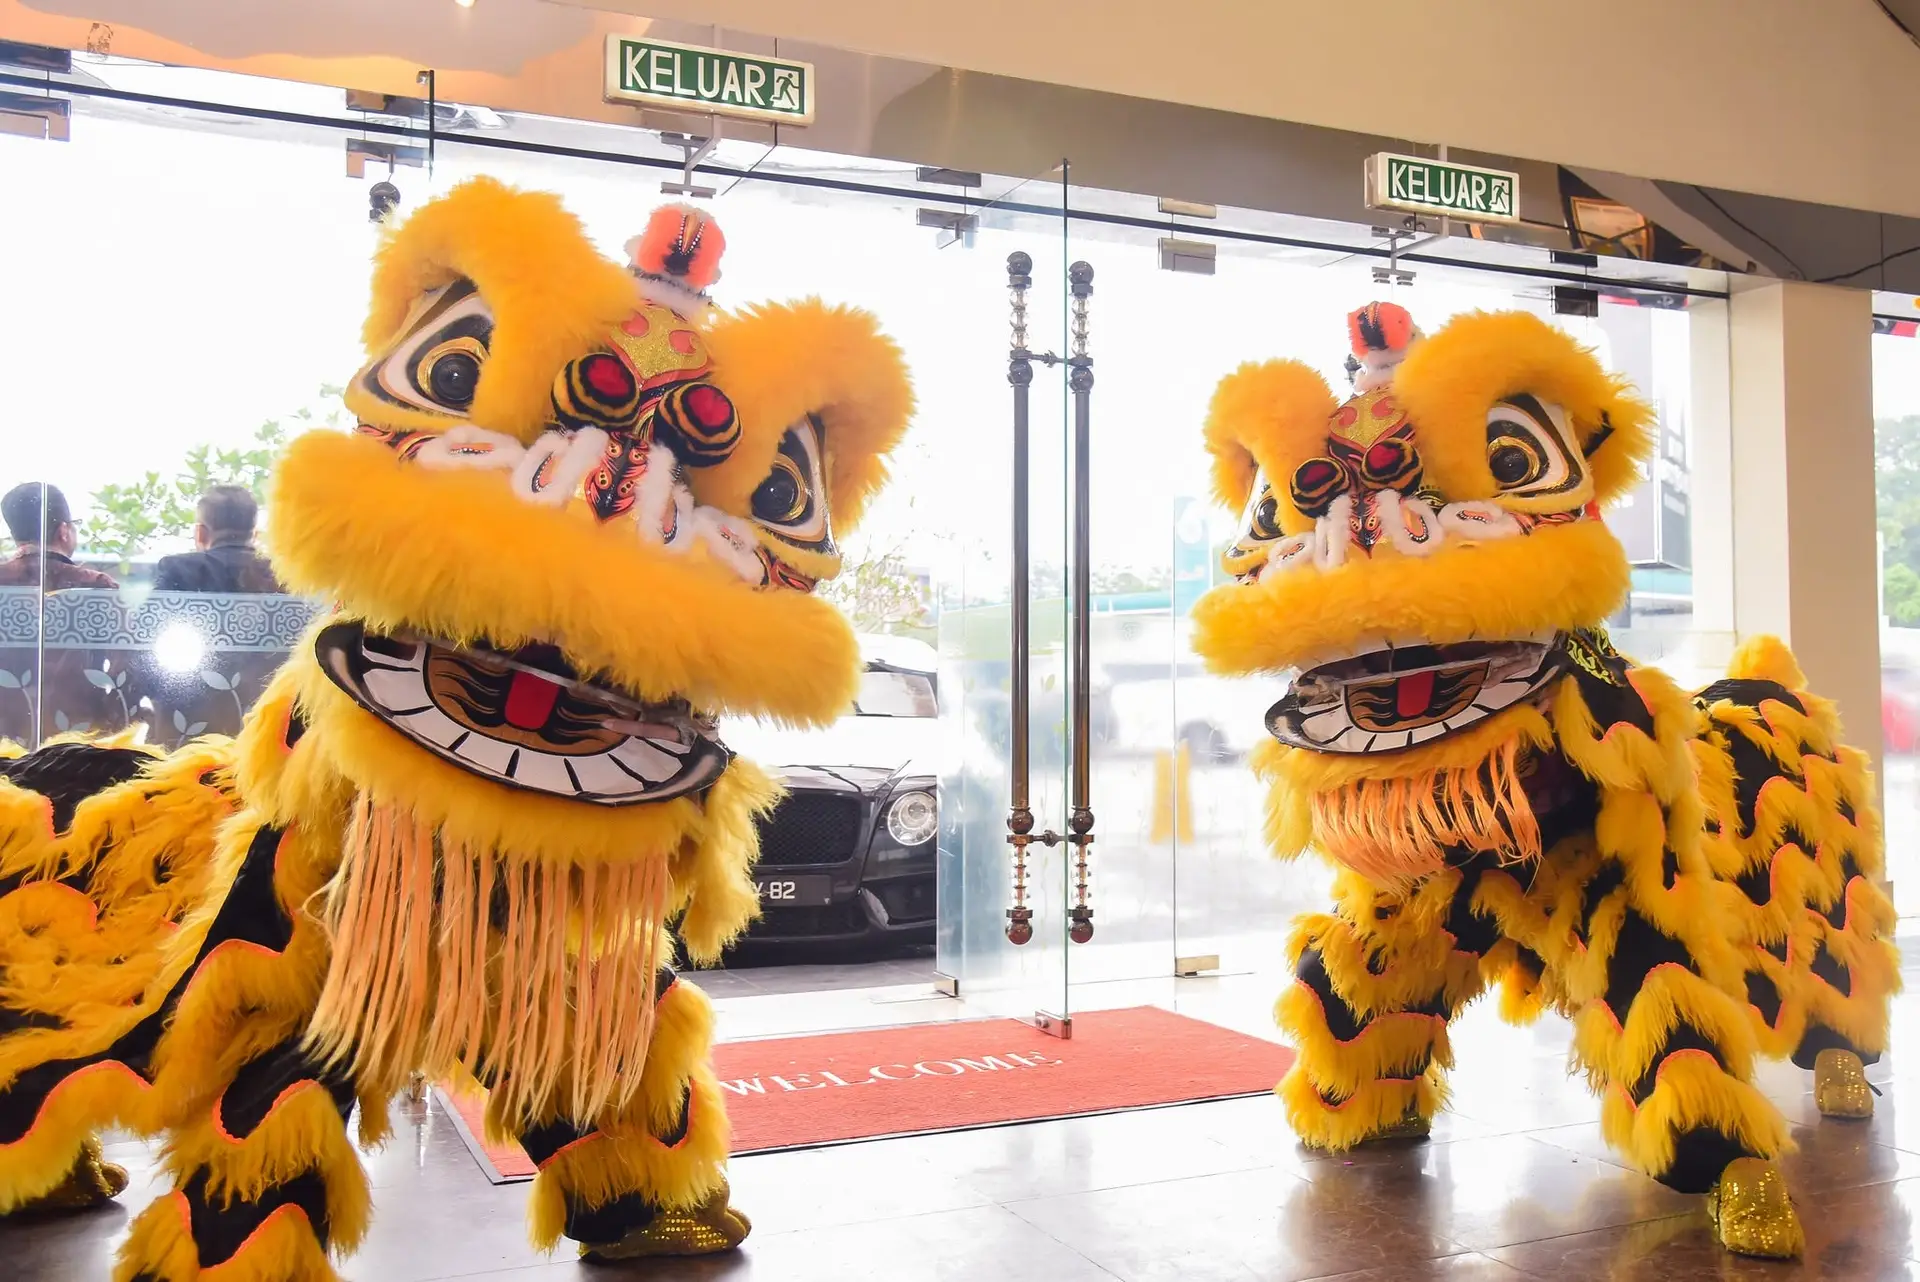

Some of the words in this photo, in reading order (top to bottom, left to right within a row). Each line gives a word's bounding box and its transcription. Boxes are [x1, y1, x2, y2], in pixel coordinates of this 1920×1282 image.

[625, 45, 766, 106] KELUAR
[1391, 162, 1487, 210] KELUAR
[769, 881, 796, 900] 82
[718, 1050, 1063, 1096] WELCOME
